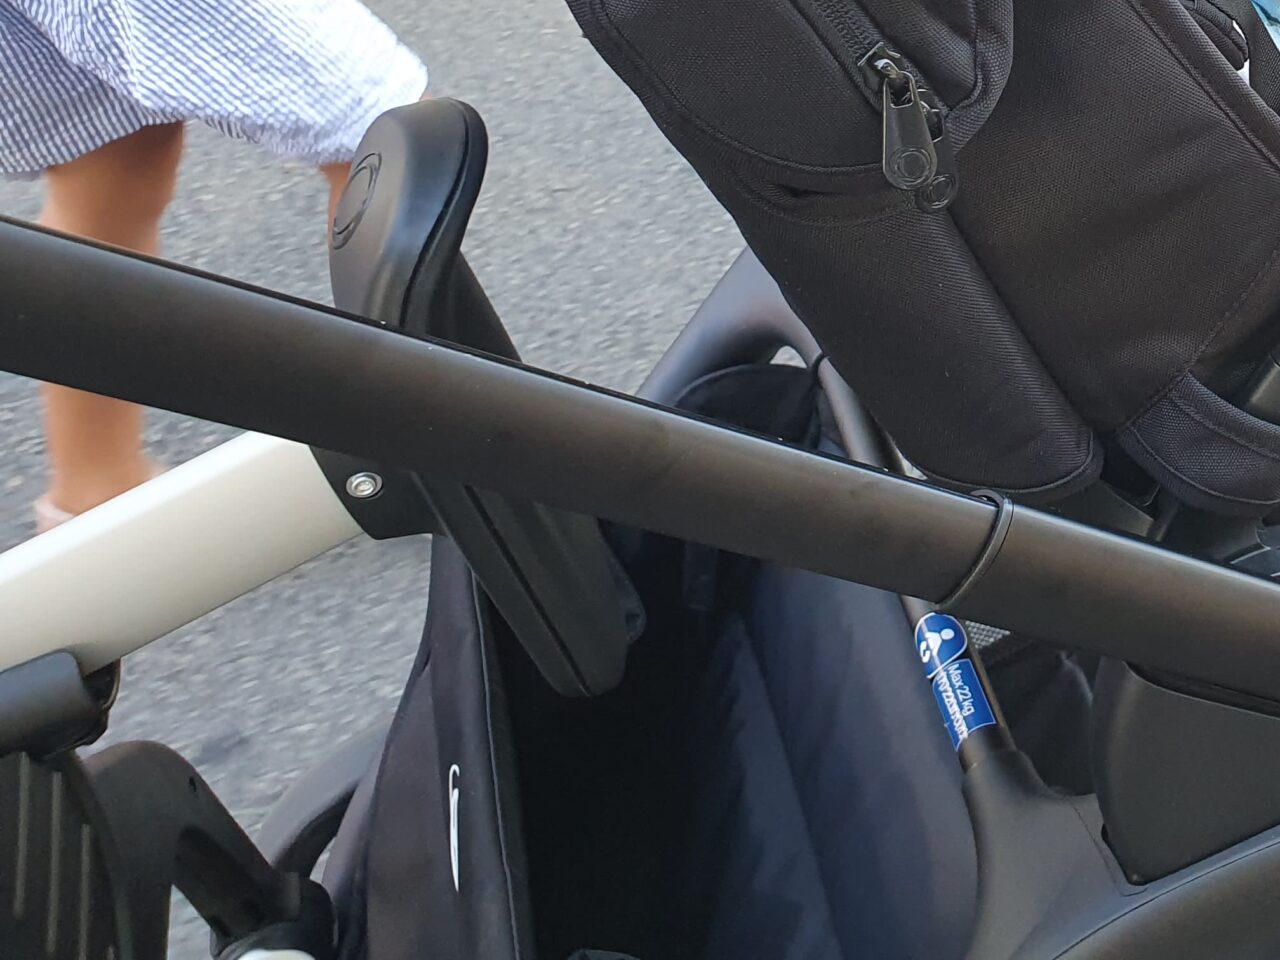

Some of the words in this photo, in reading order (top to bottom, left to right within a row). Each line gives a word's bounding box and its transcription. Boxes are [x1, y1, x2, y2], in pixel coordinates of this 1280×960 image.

[948, 663, 963, 688] Max
[956, 685, 971, 702] 22
[962, 698, 975, 716] kg
